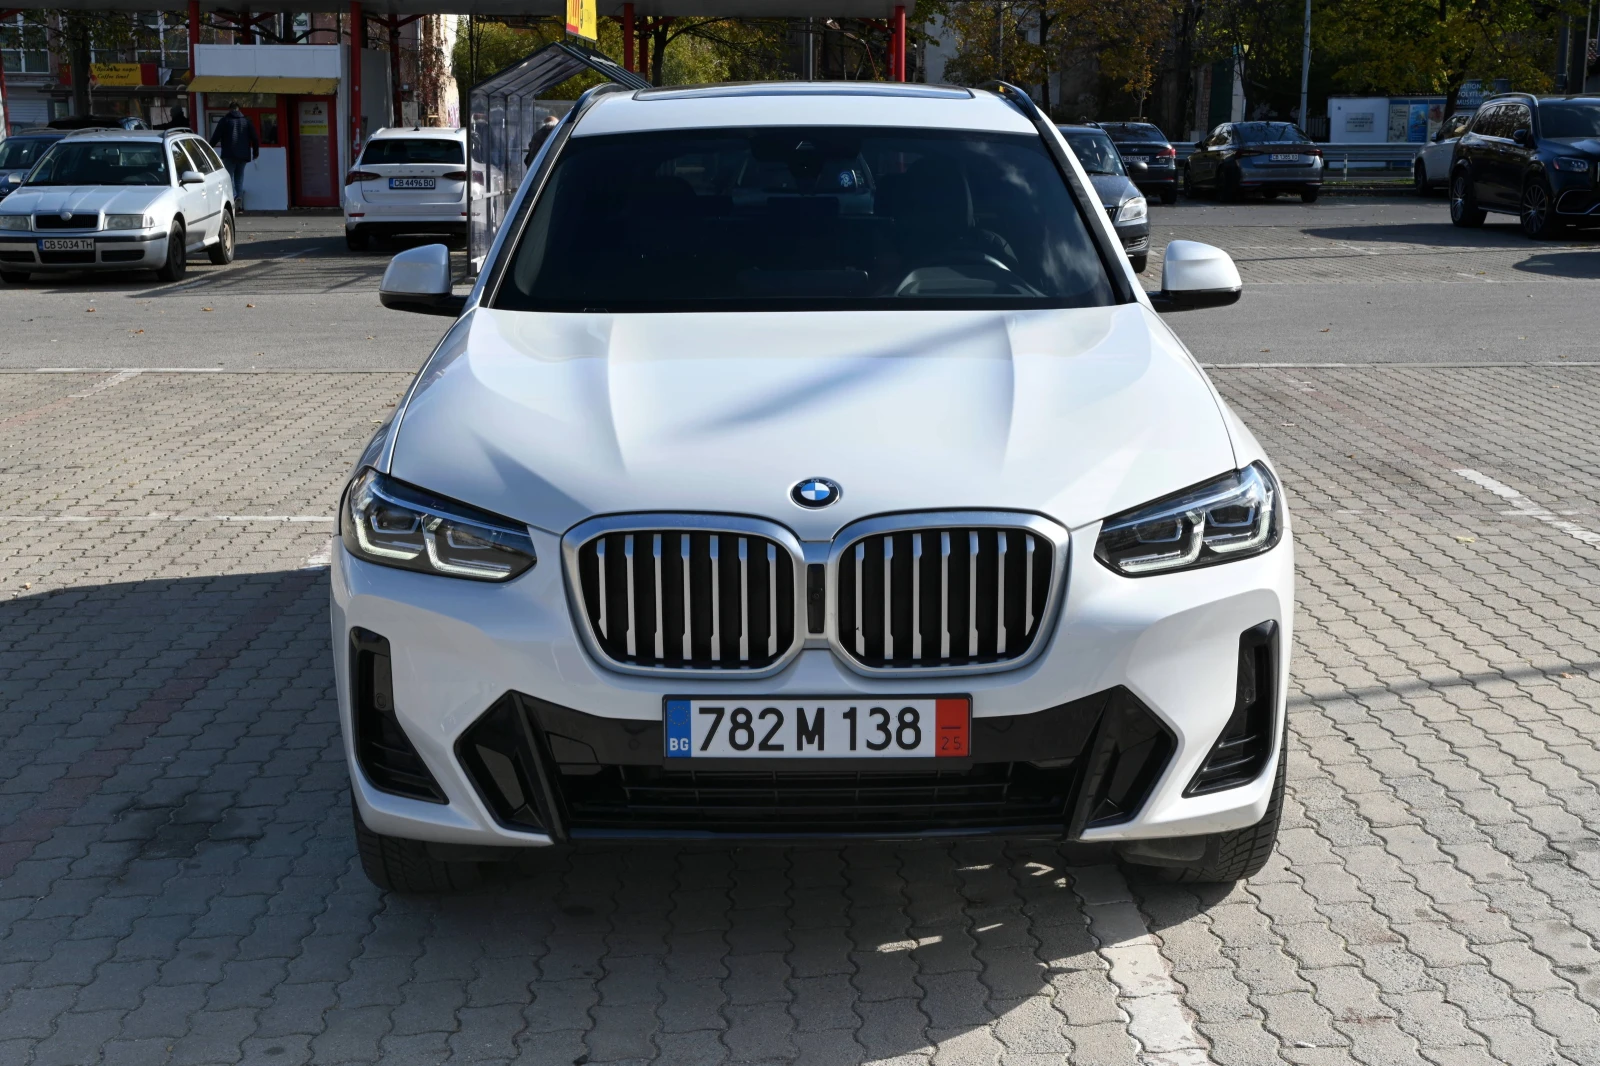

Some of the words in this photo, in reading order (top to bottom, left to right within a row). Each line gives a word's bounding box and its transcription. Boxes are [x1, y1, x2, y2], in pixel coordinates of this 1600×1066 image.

[394, 179, 404, 187] CB
[405, 179, 423, 187] 4496
[44, 240, 56, 250] CB
[57, 240, 79, 250] 5034
[80, 240, 93, 249] TH
[698, 707, 785, 752] 782
[796, 707, 825, 752] M
[842, 706, 922, 752] 138
[669, 738, 689, 750] BG
[941, 736, 962, 750] 25
